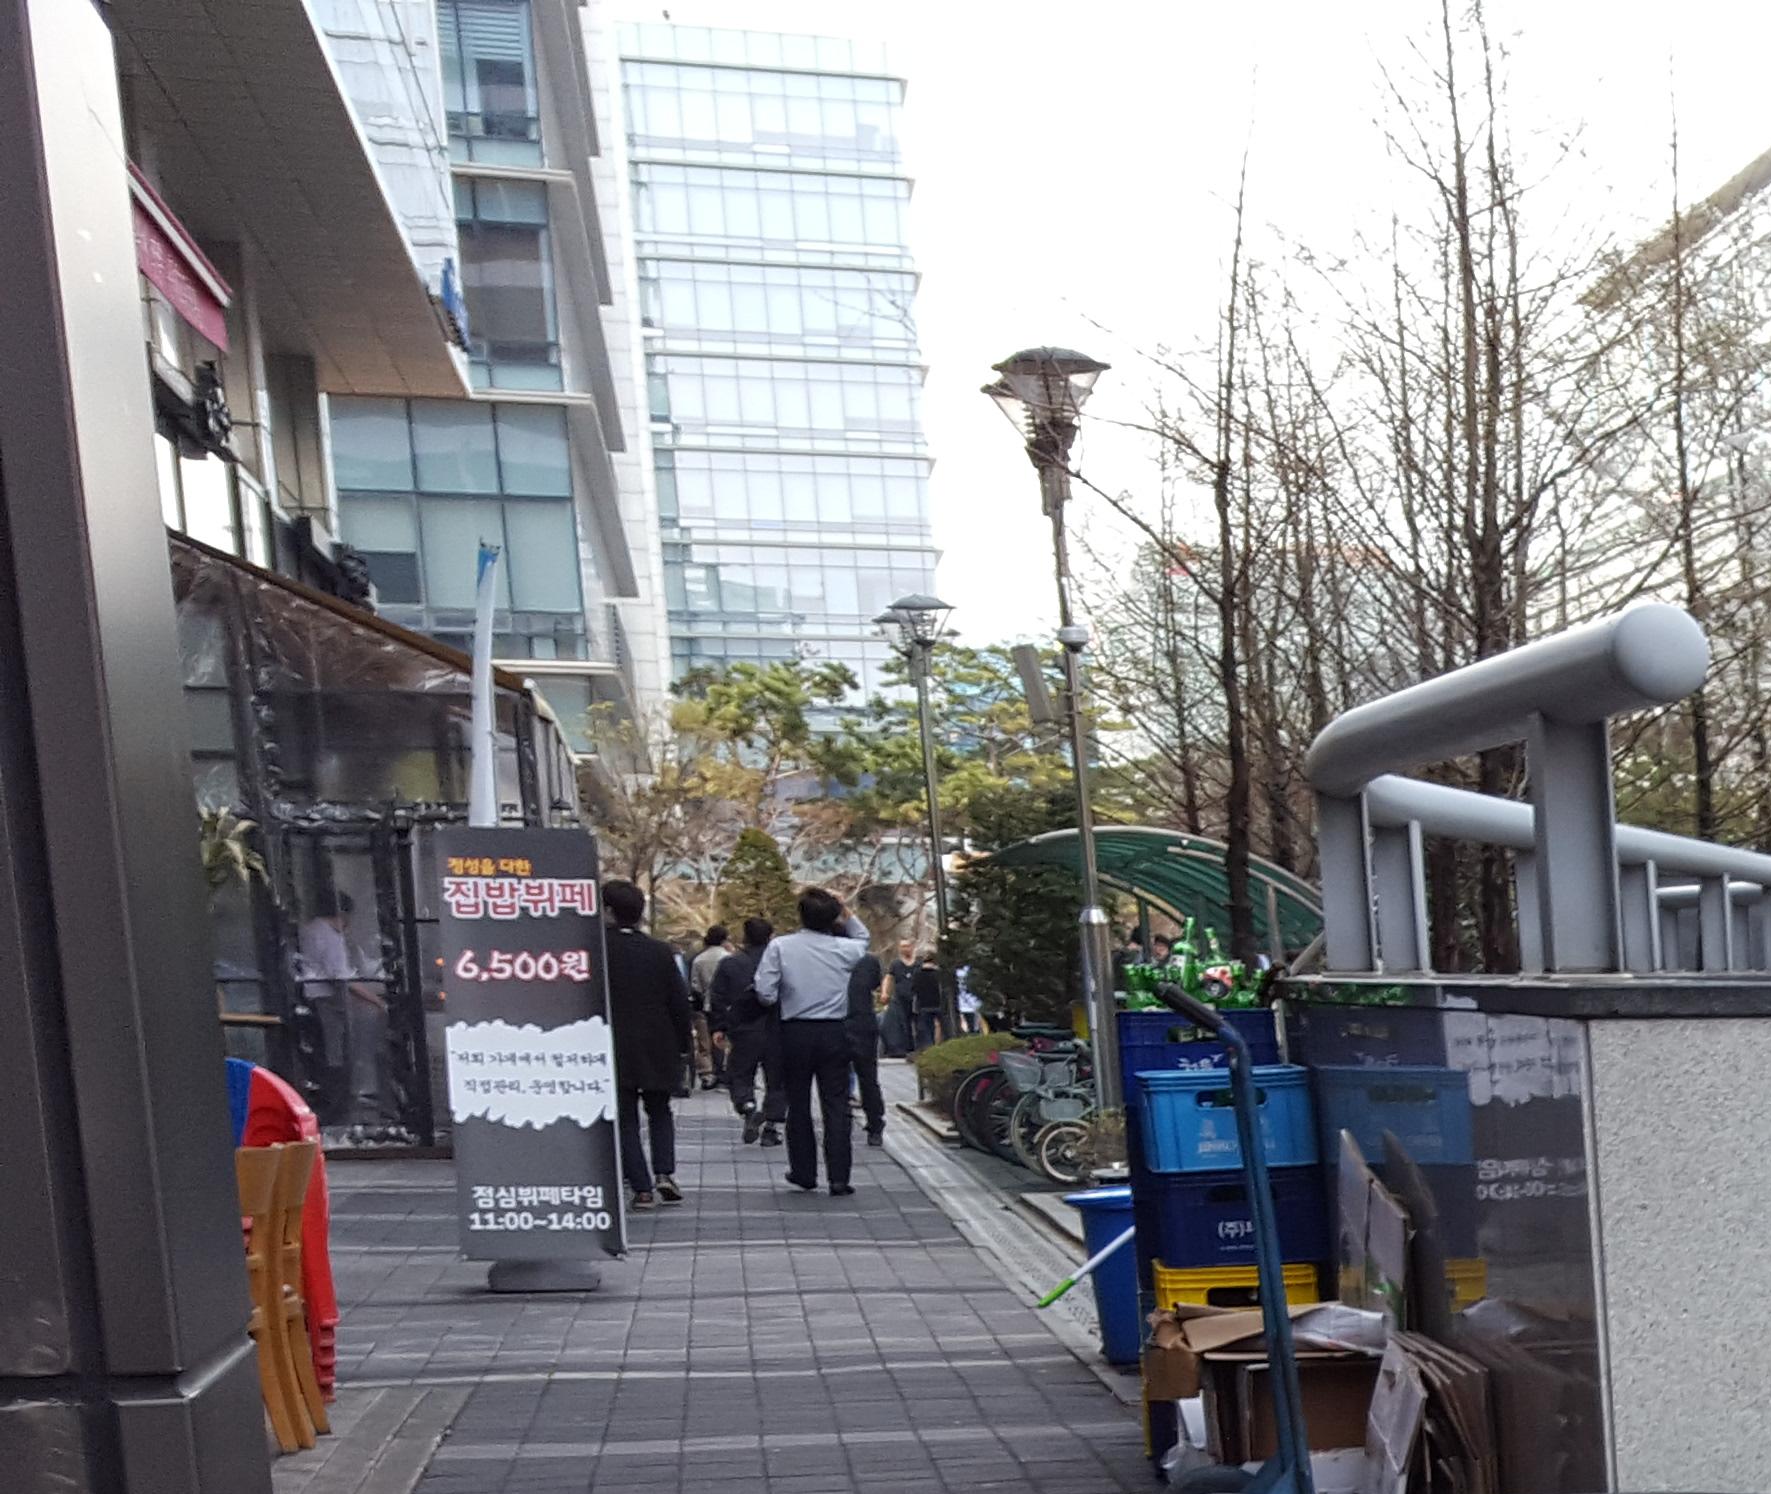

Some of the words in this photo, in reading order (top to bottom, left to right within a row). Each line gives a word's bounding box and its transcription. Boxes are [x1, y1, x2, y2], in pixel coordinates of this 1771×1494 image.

[444, 876, 597, 920] 집밥뷔페
[455, 949, 591, 982] 6,500원
[471, 1185, 604, 1209] 점심뷔페타임
[469, 1211, 612, 1231] 11:00~14:00
